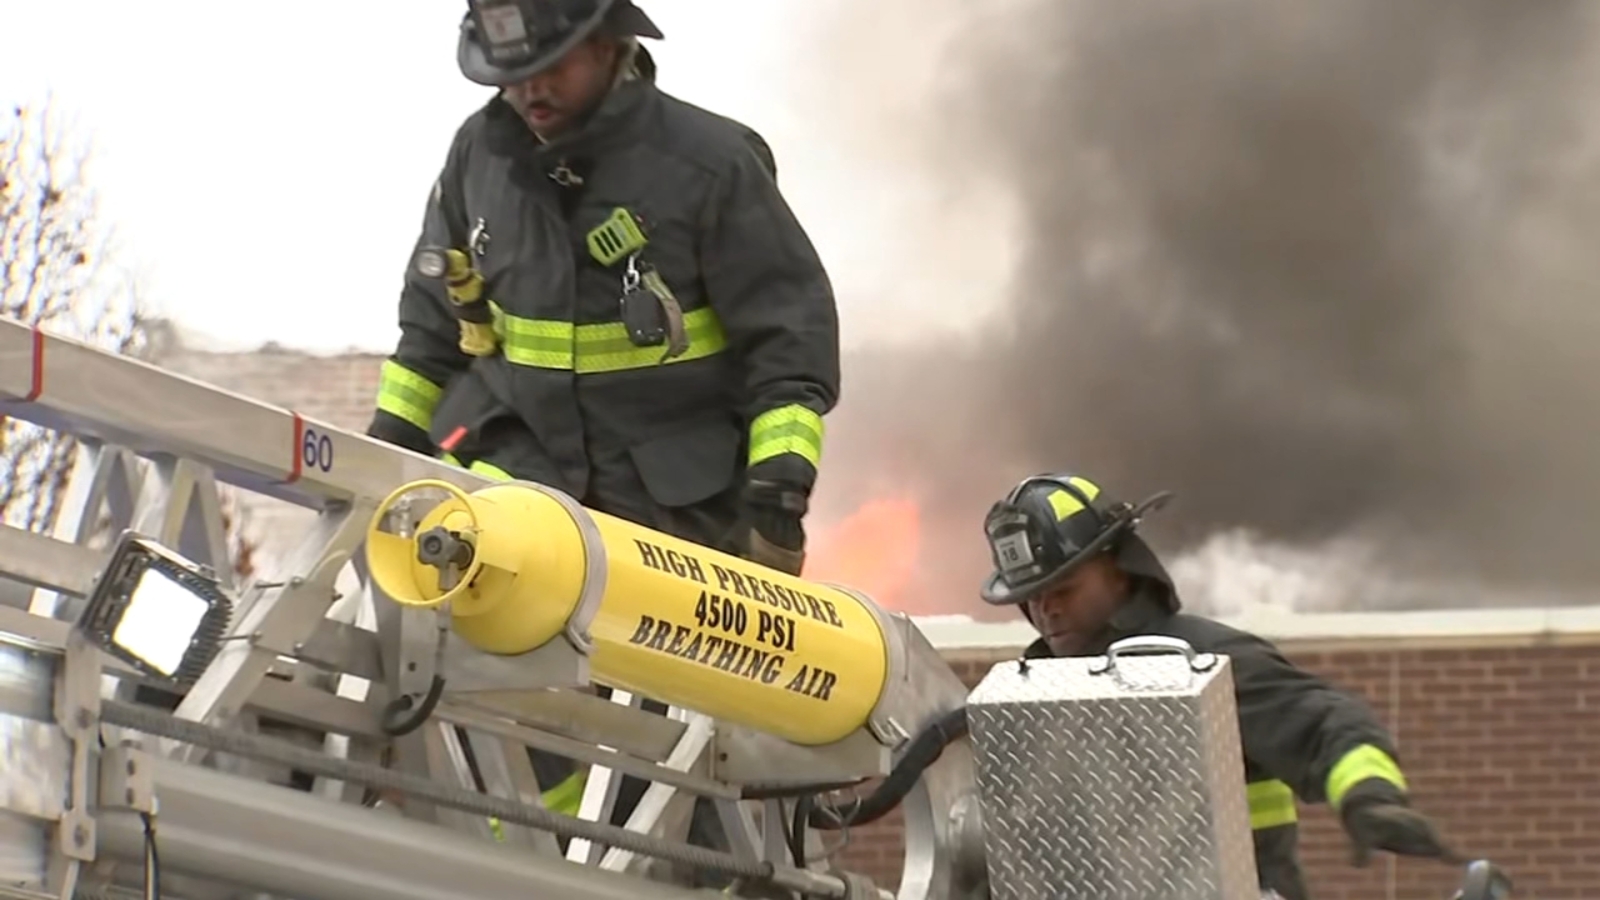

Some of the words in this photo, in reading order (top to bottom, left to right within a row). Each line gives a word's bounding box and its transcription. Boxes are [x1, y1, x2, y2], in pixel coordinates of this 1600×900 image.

[303, 429, 333, 473] 60
[633, 539, 708, 584] HIGH
[710, 563, 843, 628] PRESSURE
[629, 615, 785, 684] BREATHING
[785, 664, 837, 701] AIR
[694, 590, 747, 636] 4500
[756, 610, 796, 652] PSI
